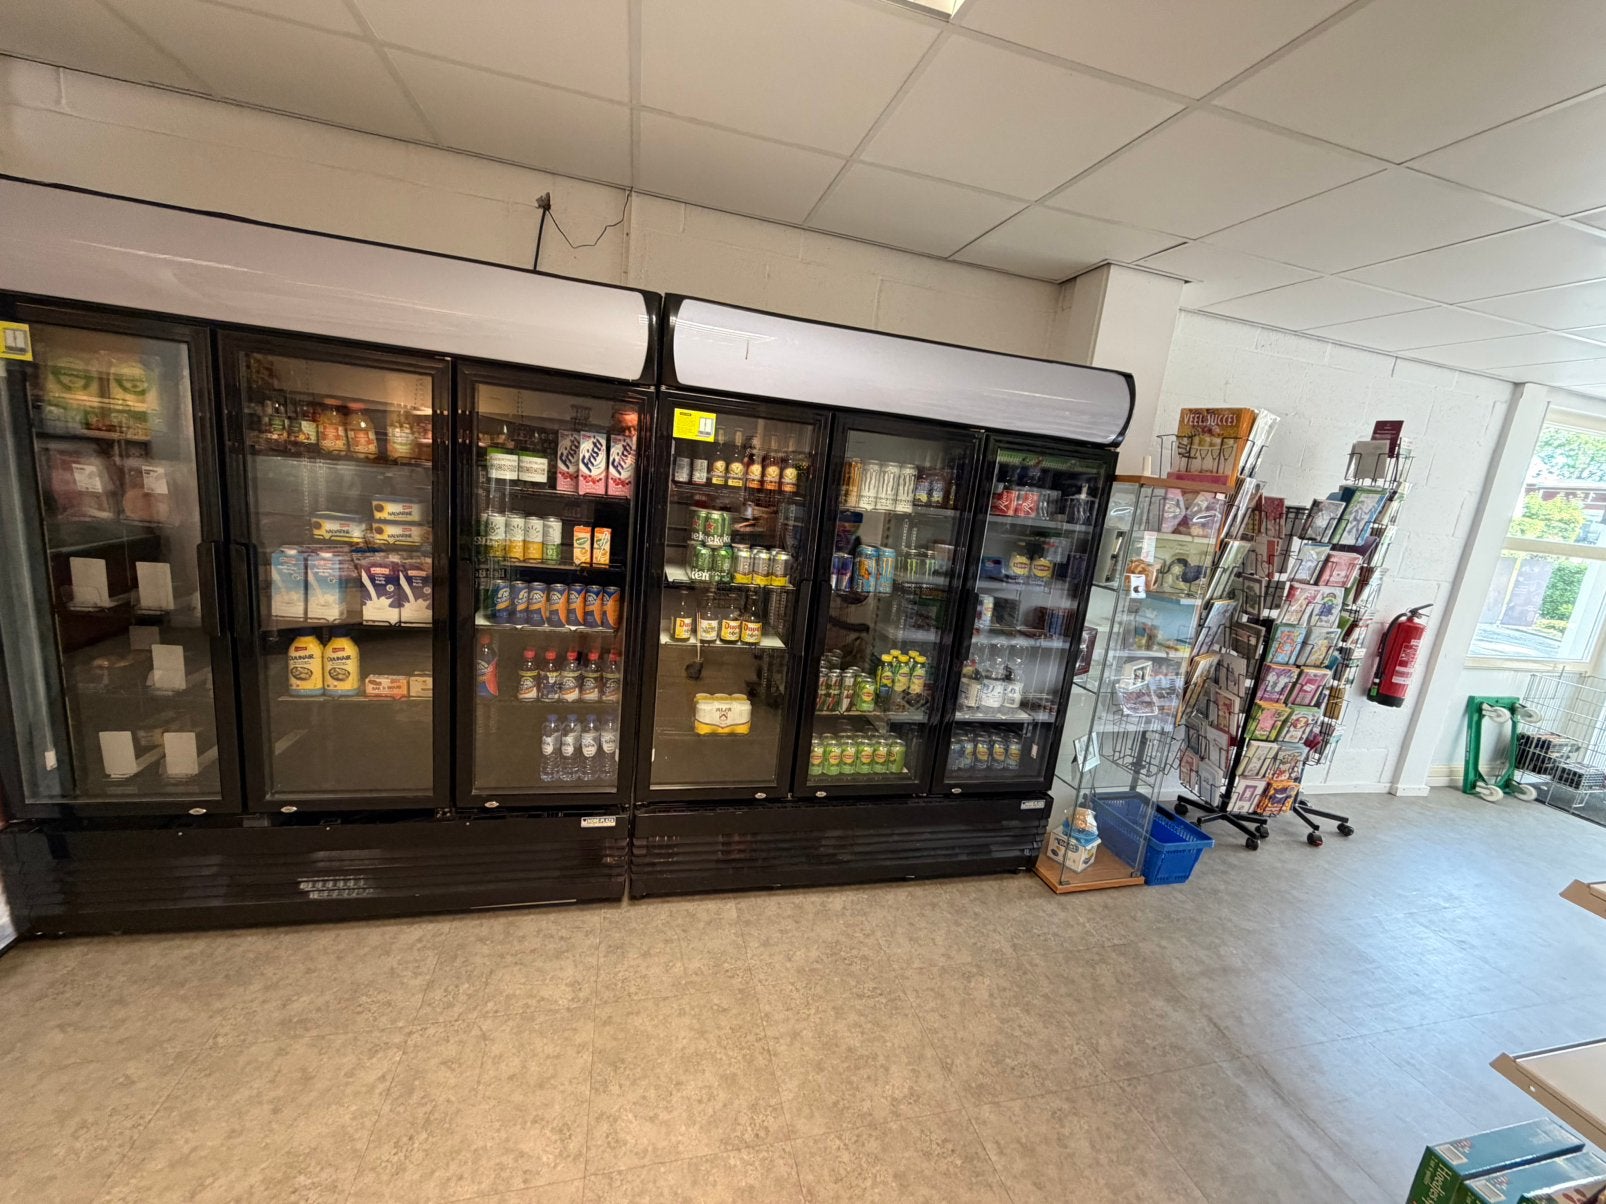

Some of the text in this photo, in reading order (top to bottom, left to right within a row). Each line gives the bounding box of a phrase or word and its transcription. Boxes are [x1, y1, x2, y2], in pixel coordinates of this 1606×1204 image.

[1184, 413, 1237, 426] VEEL SUCCES
[559, 434, 580, 470] Fristi
[581, 435, 604, 474] Fristi
[610, 438, 633, 476] Fristi
